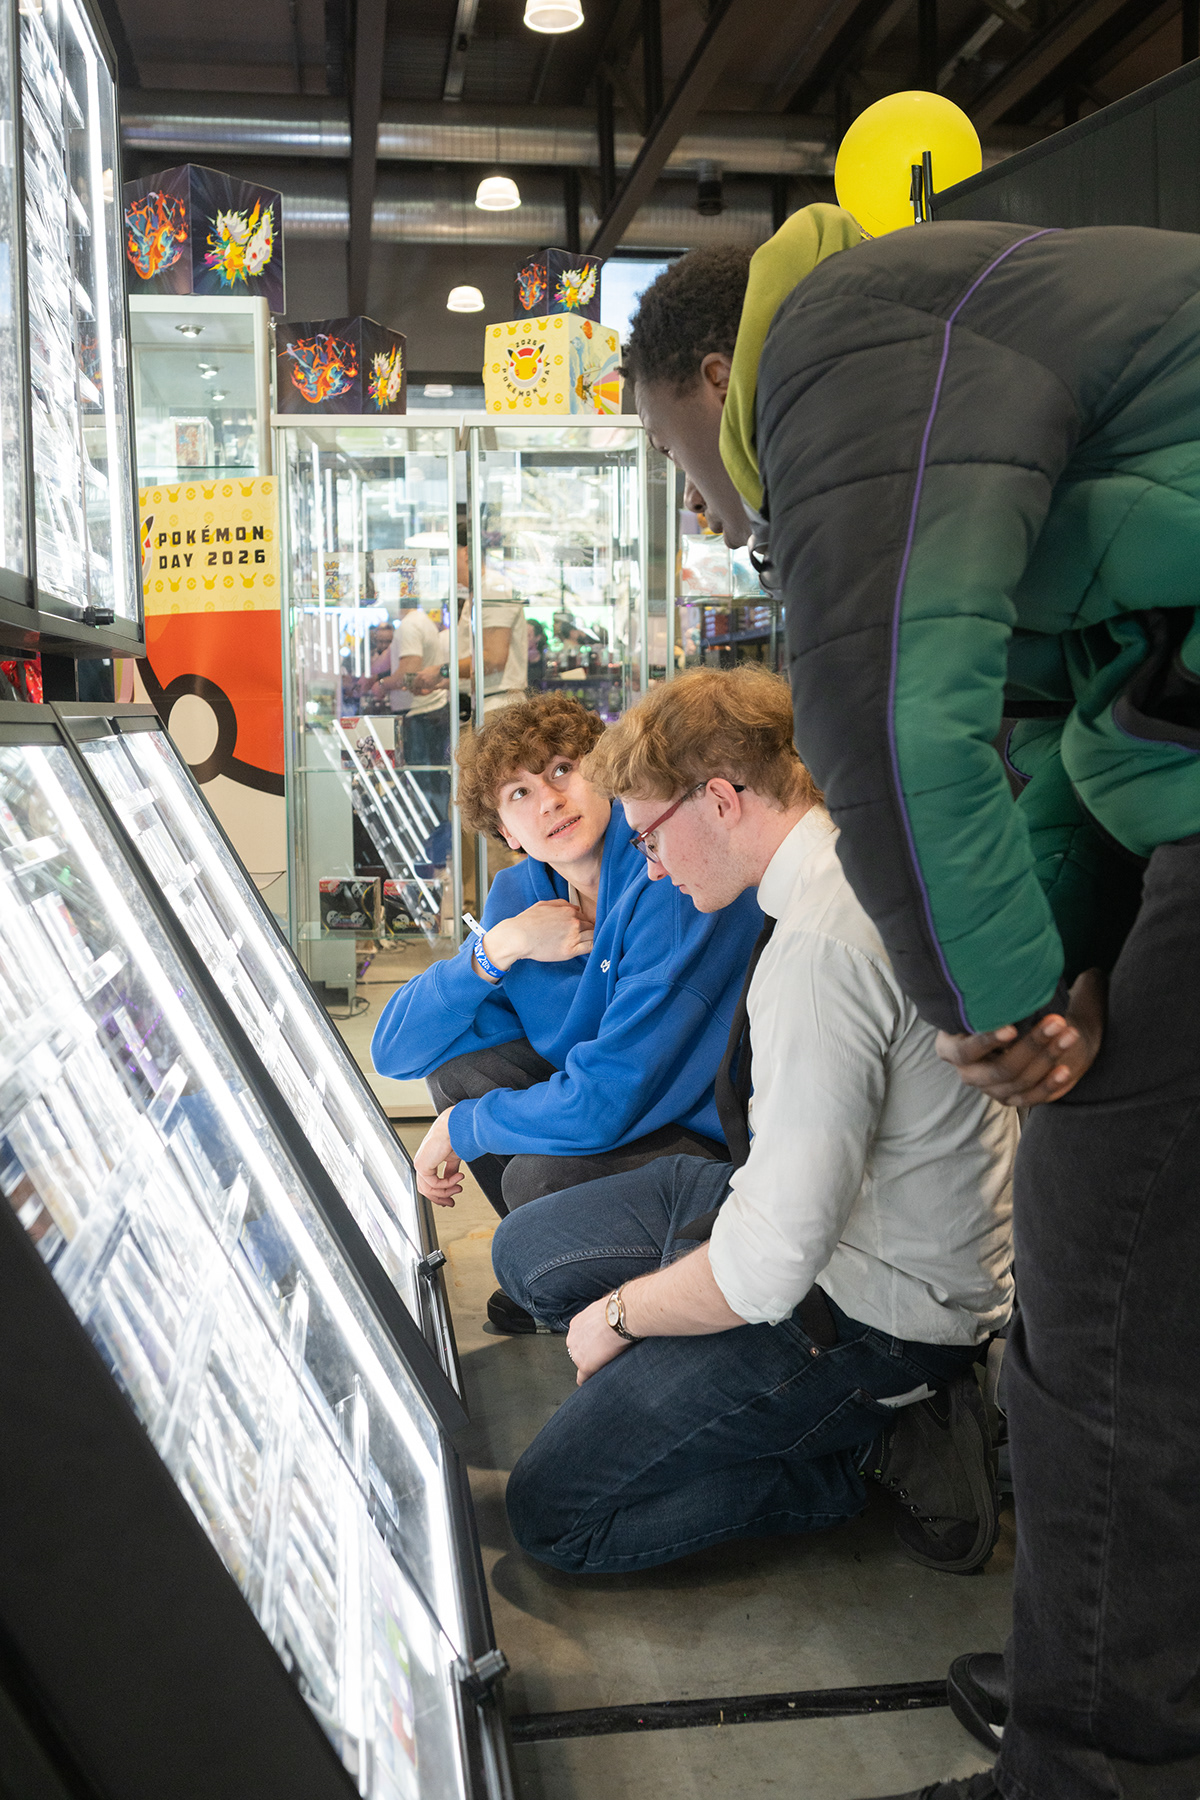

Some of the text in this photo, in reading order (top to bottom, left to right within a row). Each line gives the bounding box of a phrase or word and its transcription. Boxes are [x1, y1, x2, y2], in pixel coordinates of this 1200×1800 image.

[515, 339, 537, 348] 2026
[541, 362, 550, 383] DAY
[158, 524, 264, 547] POKÉMON
[159, 549, 266, 569] DAY 2026
